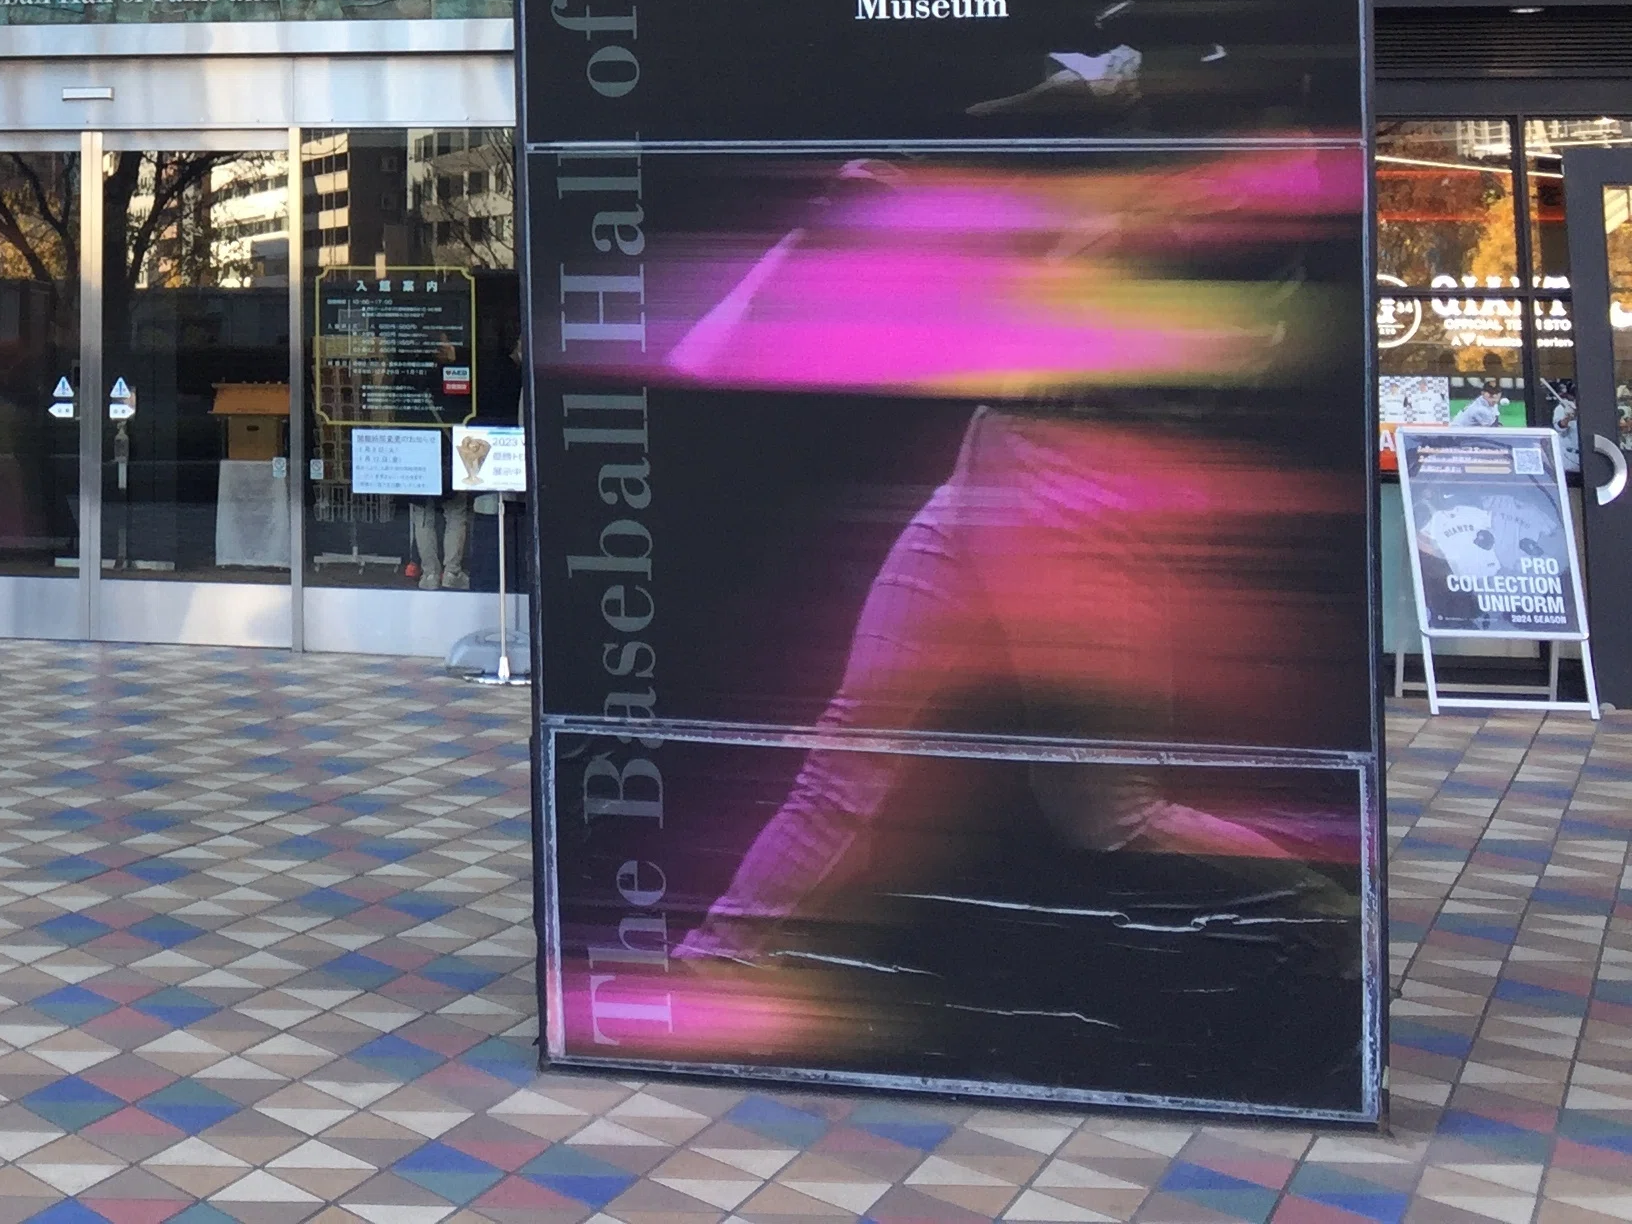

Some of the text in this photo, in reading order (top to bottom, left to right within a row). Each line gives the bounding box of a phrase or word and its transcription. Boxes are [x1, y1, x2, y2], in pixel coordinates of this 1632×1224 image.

[557, 132, 646, 353] Hall
[1520, 557, 1560, 575] PRO
[1447, 575, 1563, 595] COLLECTION
[563, 387, 666, 828] Baseball
[1477, 594, 1566, 614] UNIFORM
[1511, 614, 1533, 624] 2024
[1534, 615, 1567, 625] SEASON
[587, 860, 674, 1048] The
